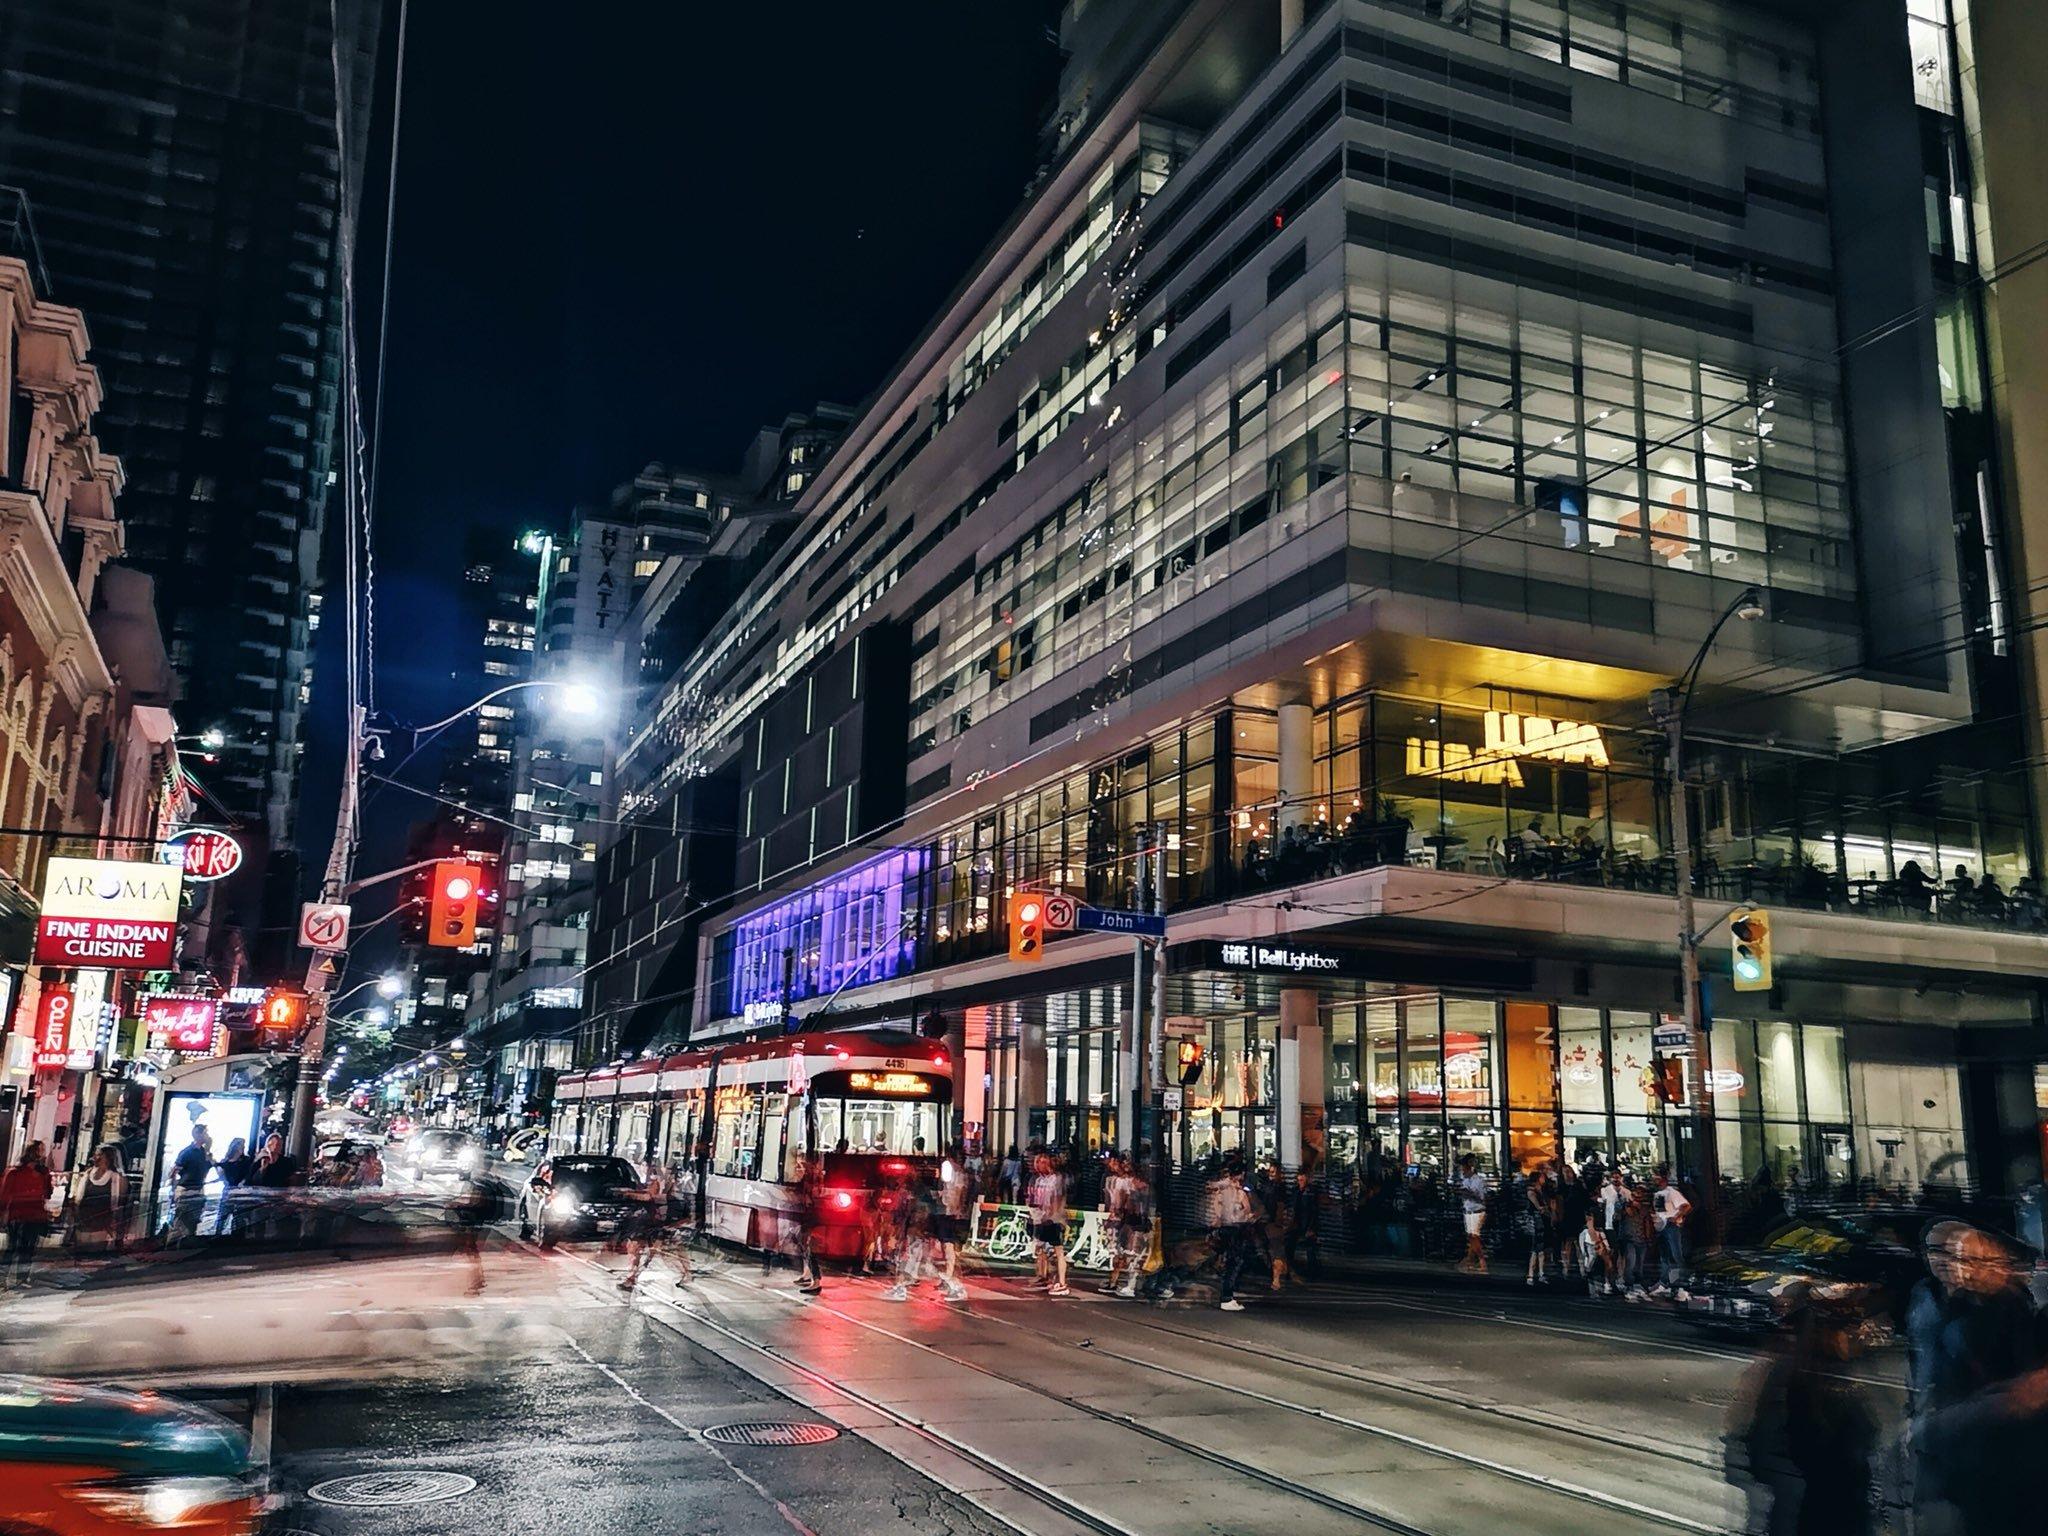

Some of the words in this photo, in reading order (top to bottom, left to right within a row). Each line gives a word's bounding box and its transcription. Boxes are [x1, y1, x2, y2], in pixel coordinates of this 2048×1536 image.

[596, 527, 618, 629] HYATT
[55, 872, 170, 901] AROMA
[46, 920, 91, 938] FINE
[96, 923, 169, 942] INDIAN
[1100, 913, 1133, 928] John
[64, 940, 146, 958] CUISINE
[45, 996, 69, 1050] OPEN
